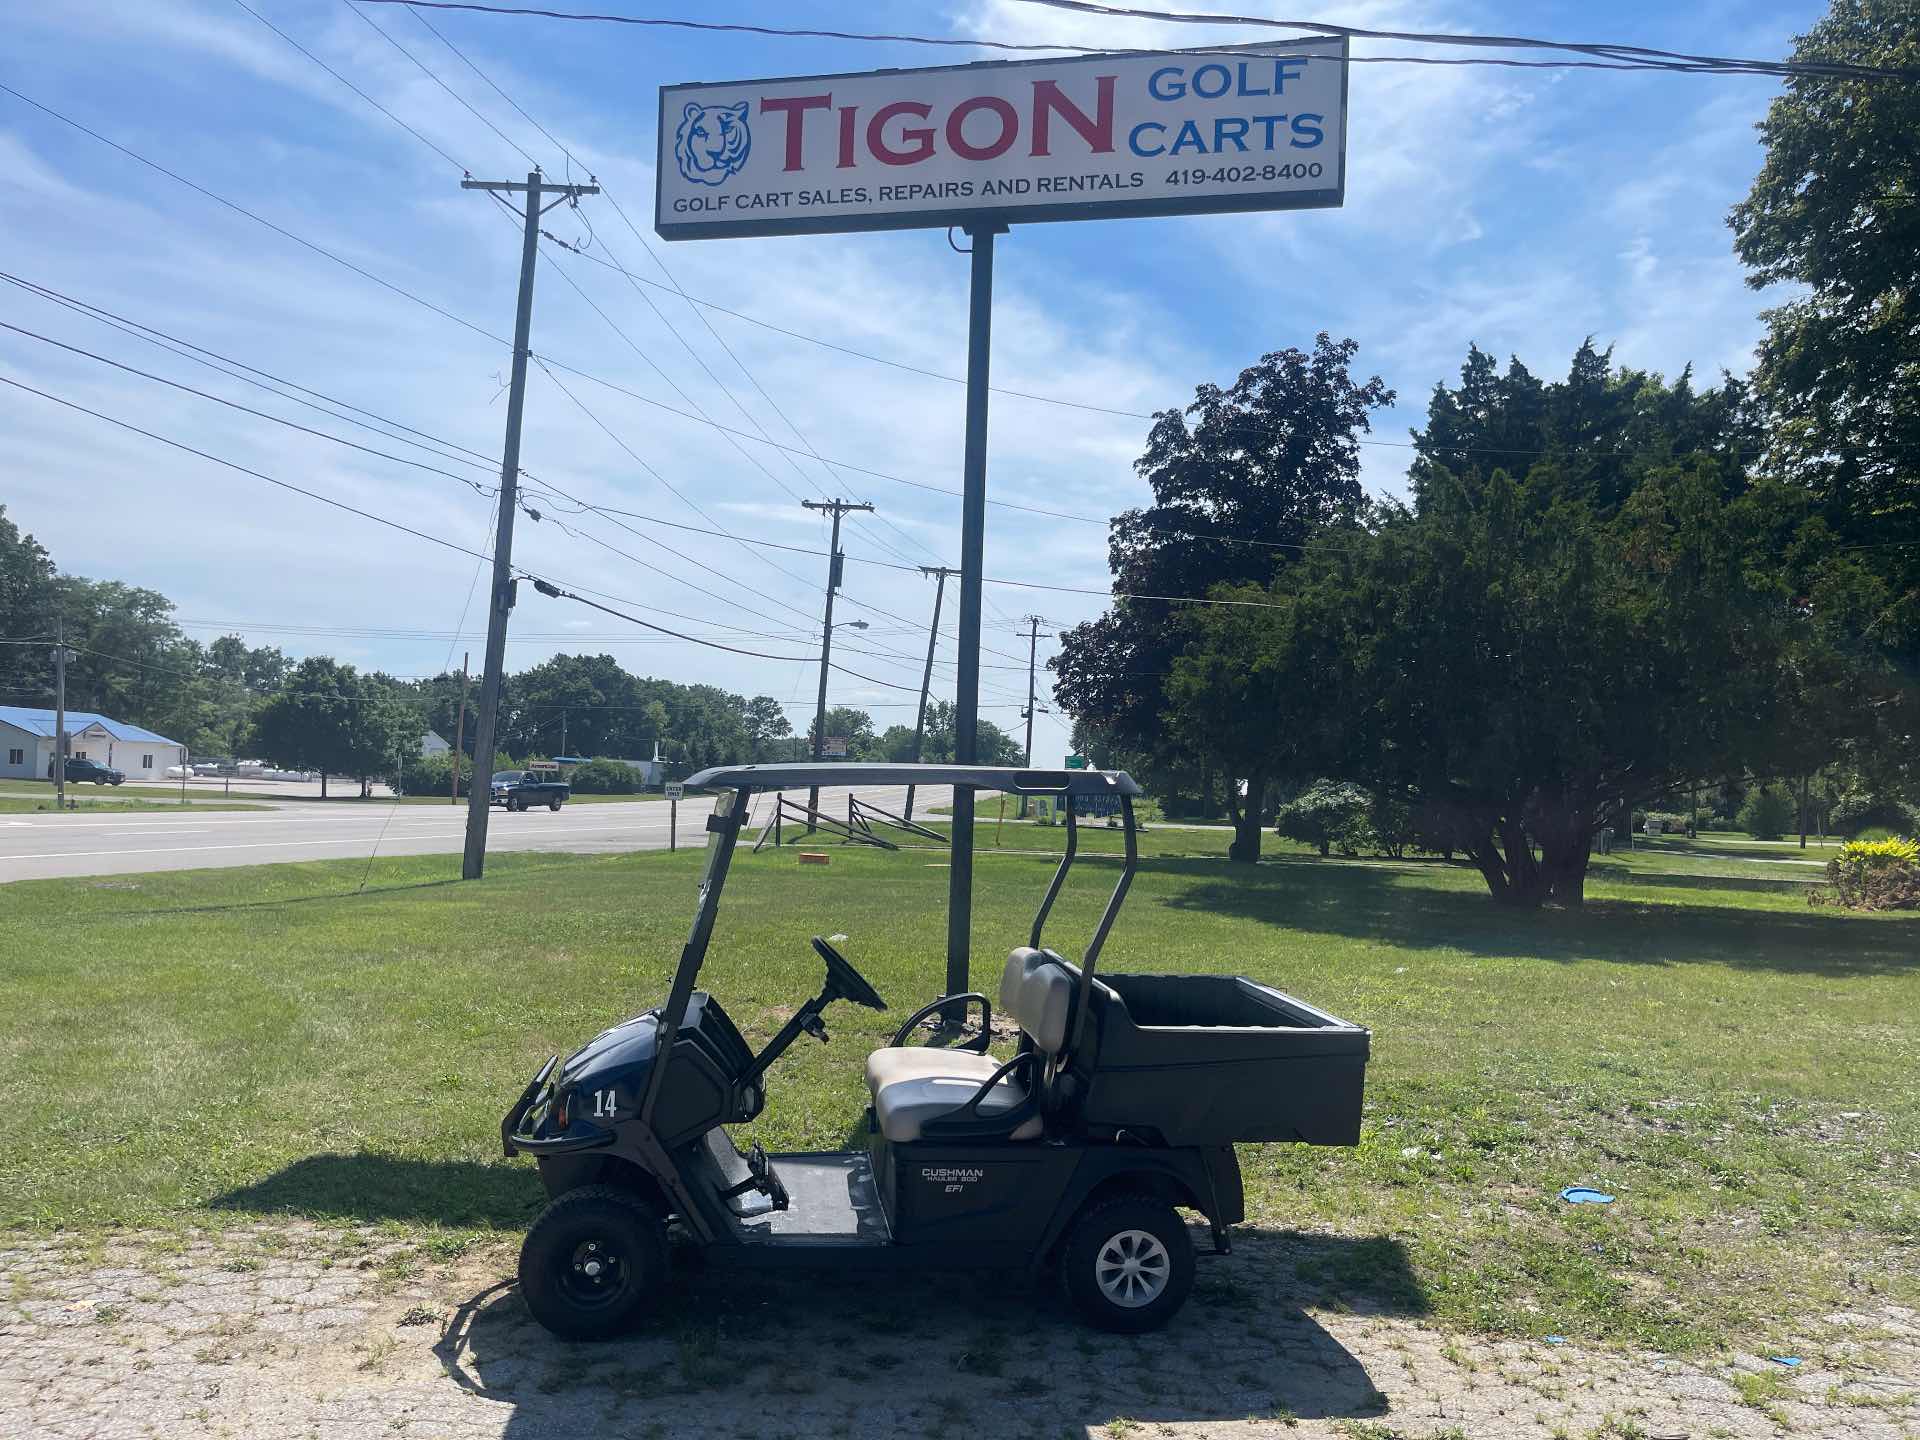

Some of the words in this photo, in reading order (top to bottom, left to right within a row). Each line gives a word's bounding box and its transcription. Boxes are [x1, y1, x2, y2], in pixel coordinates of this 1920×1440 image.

[1148, 58, 1309, 101] GOLF
[760, 75, 1119, 172] TIGON
[1128, 113, 1325, 157] CARTS
[1165, 162, 1323, 186] 419-402-8400
[673, 196, 730, 213] GOLF
[735, 191, 793, 210] CART
[798, 187, 873, 206] SALES,
[879, 181, 973, 201] REPAIRS
[981, 177, 1031, 195] AND
[1037, 172, 1144, 192] RENTALS
[594, 1089, 616, 1117] 14
[921, 1168, 984, 1177] CUSHMAN
[945, 1184, 964, 1193] EFI
